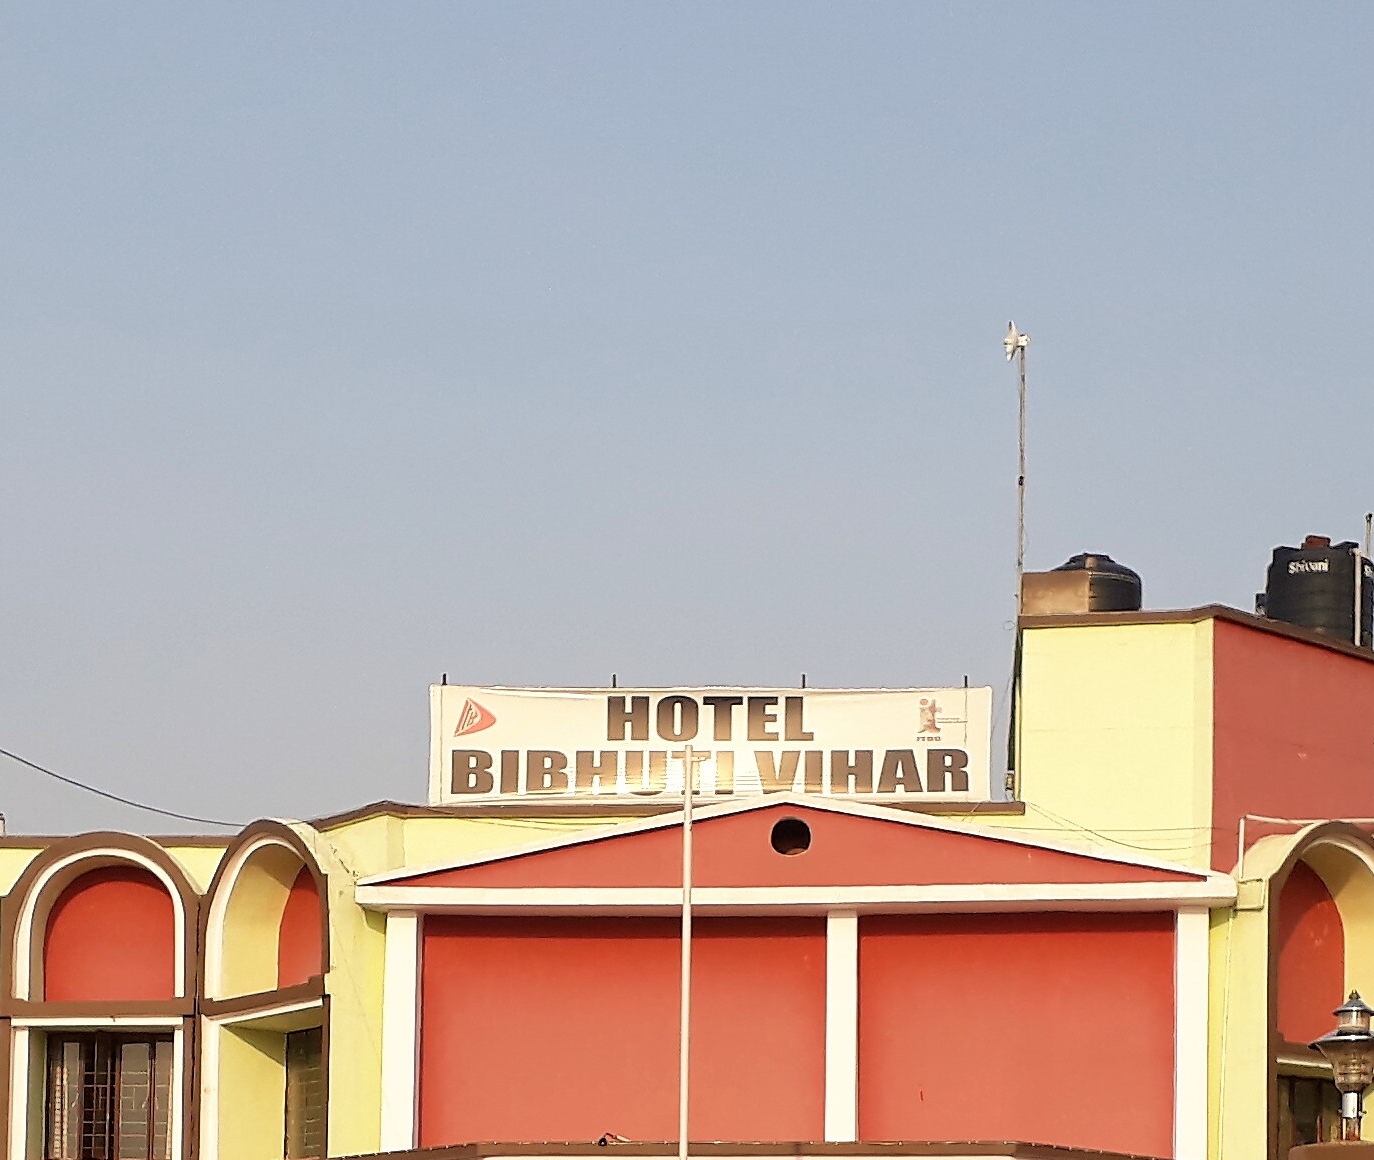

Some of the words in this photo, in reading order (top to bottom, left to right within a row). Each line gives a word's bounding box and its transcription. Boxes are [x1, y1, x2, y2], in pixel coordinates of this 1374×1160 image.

[607, 695, 814, 741] HOTEL
[451, 749, 734, 795] BIBHUTI
[754, 749, 969, 795] VIHAR
